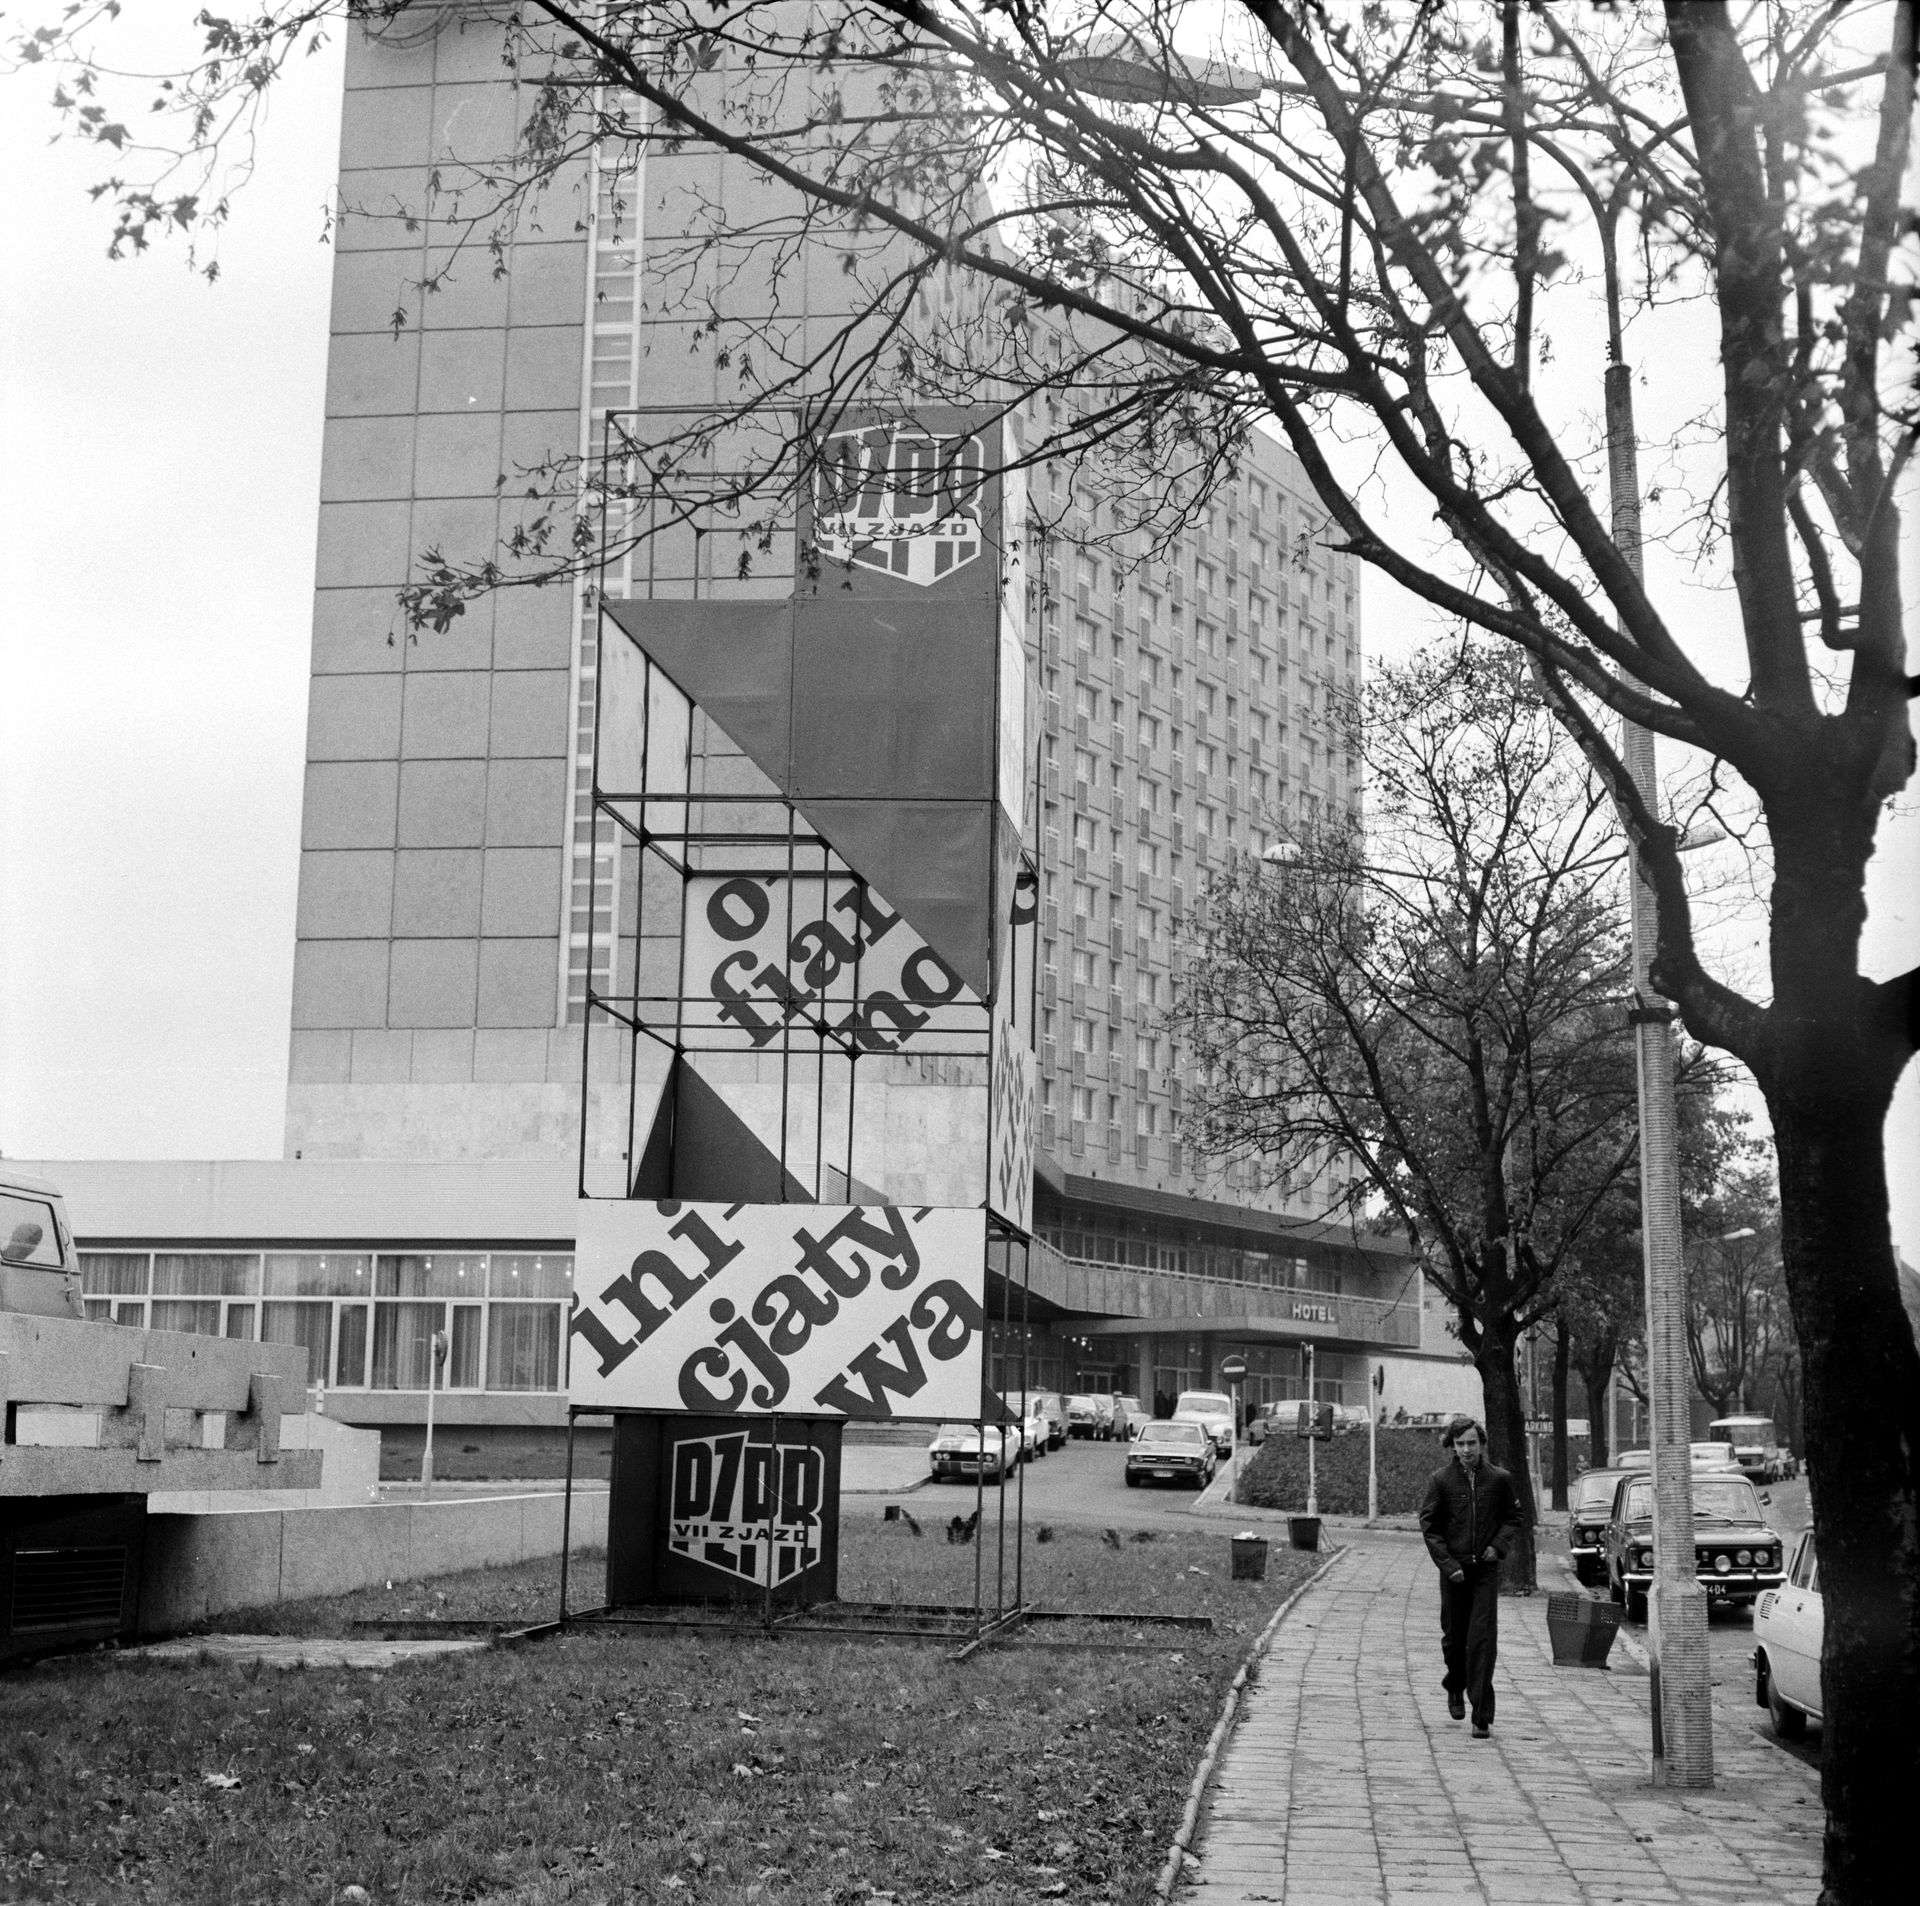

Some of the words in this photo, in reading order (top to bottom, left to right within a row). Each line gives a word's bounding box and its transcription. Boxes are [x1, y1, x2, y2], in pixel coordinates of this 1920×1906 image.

[1292, 1303, 1335, 1321] HOTEL
[813, 1279, 984, 1416] wa
[1524, 1420, 1555, 1433] ARKING
[674, 1523, 709, 1538] VII
[719, 1526, 806, 1542] ZJAZD
